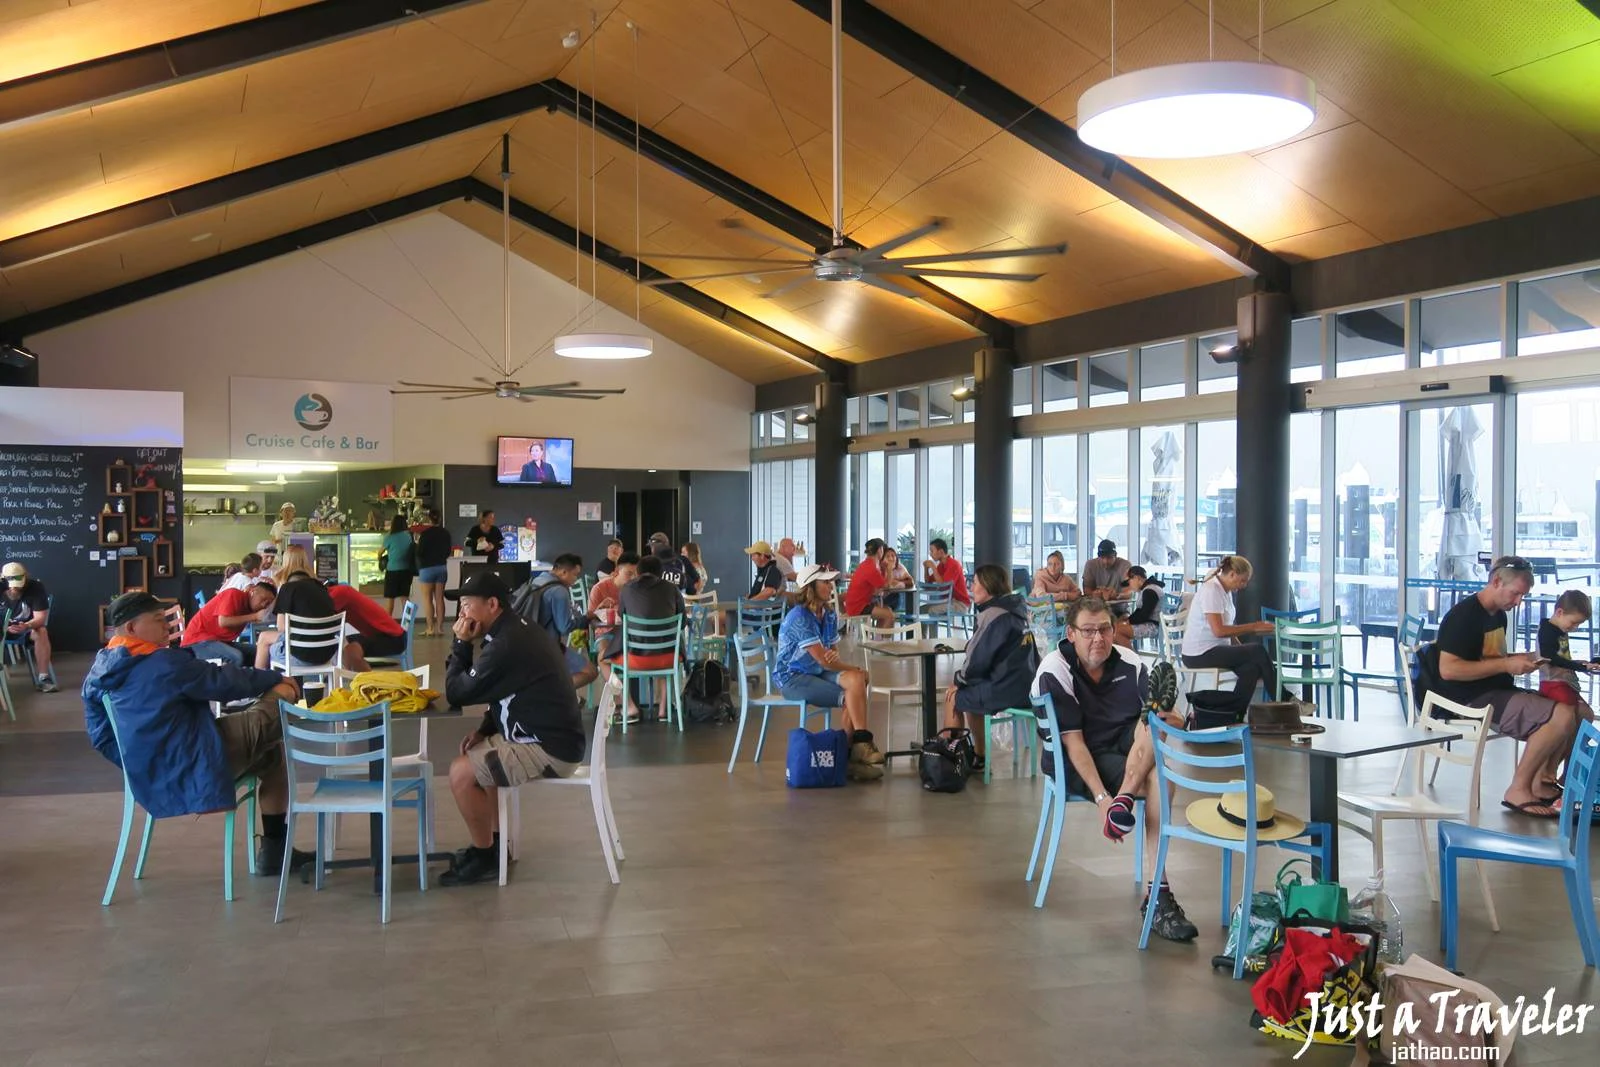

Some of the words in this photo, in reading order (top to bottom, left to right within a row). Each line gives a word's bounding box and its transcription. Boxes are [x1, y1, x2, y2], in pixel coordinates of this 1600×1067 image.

[246, 433, 294, 448] Cruise
[300, 435, 335, 450] Cafe
[340, 437, 351, 450] &
[356, 437, 380, 451] Bar
